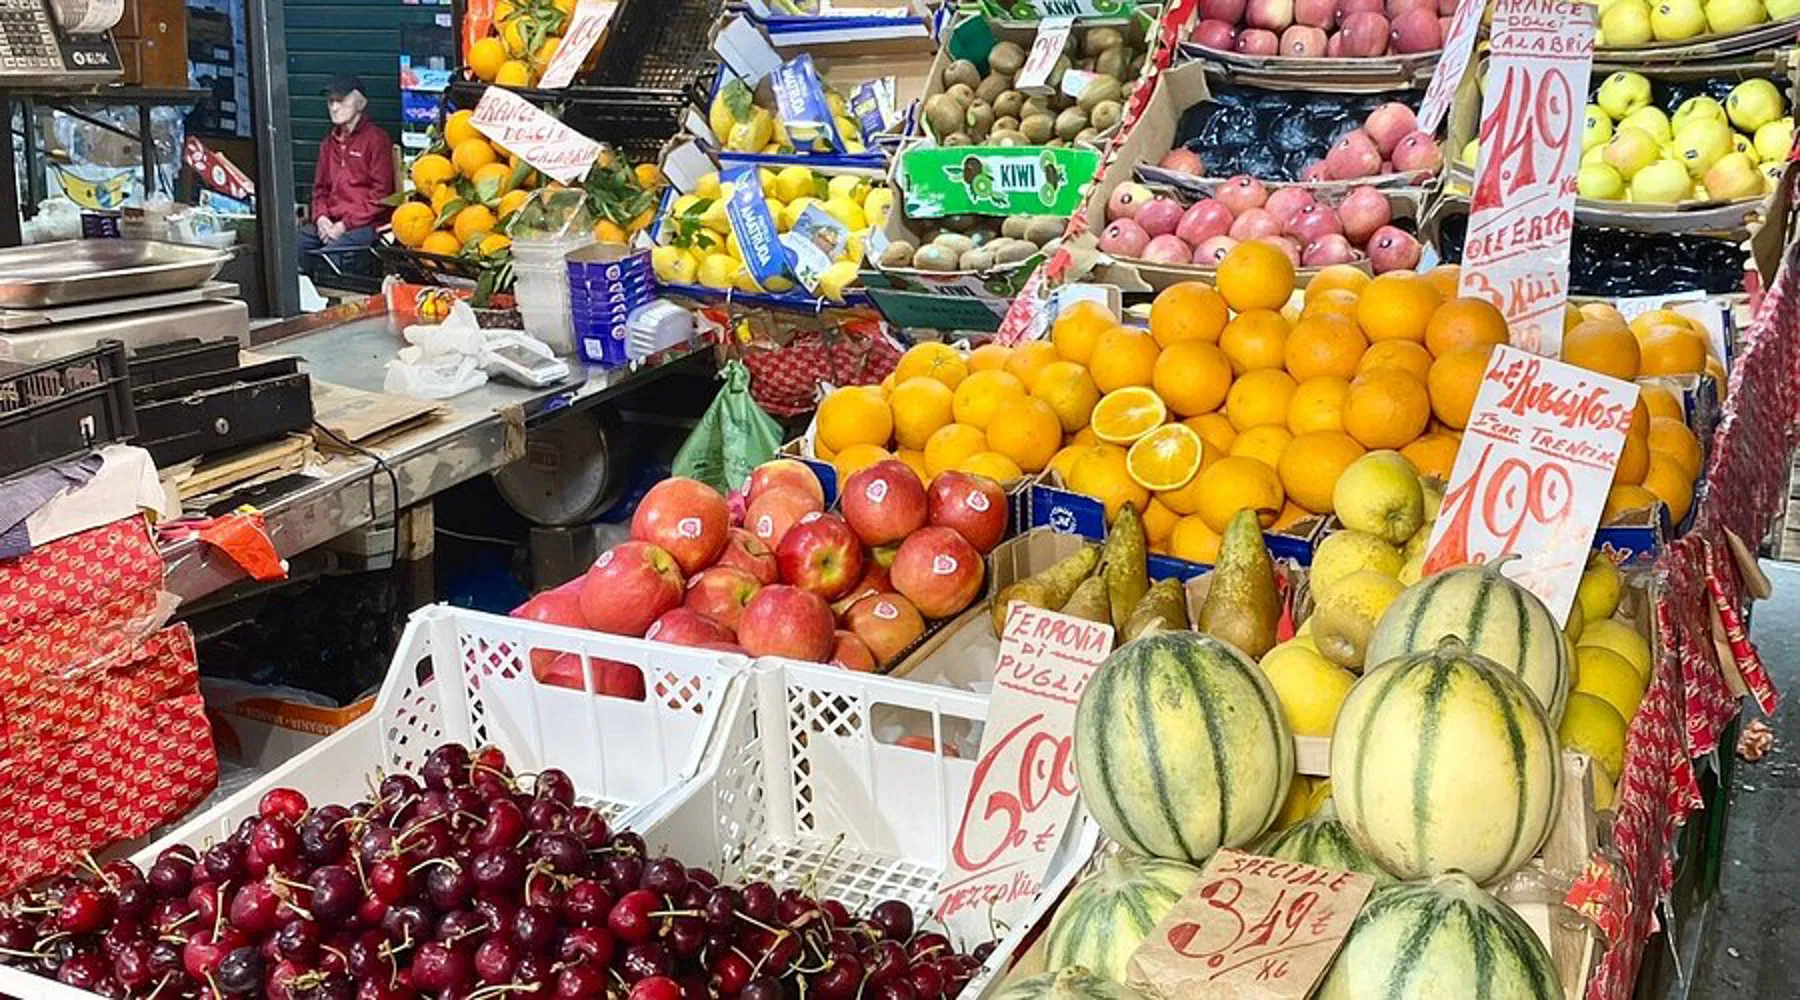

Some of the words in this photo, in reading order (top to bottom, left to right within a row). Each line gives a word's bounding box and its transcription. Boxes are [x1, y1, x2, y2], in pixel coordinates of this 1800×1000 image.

[1000, 164, 1036, 188] KIWI
[1465, 206, 1571, 260] OFFERTA
[1167, 877, 1320, 968] 3.49
